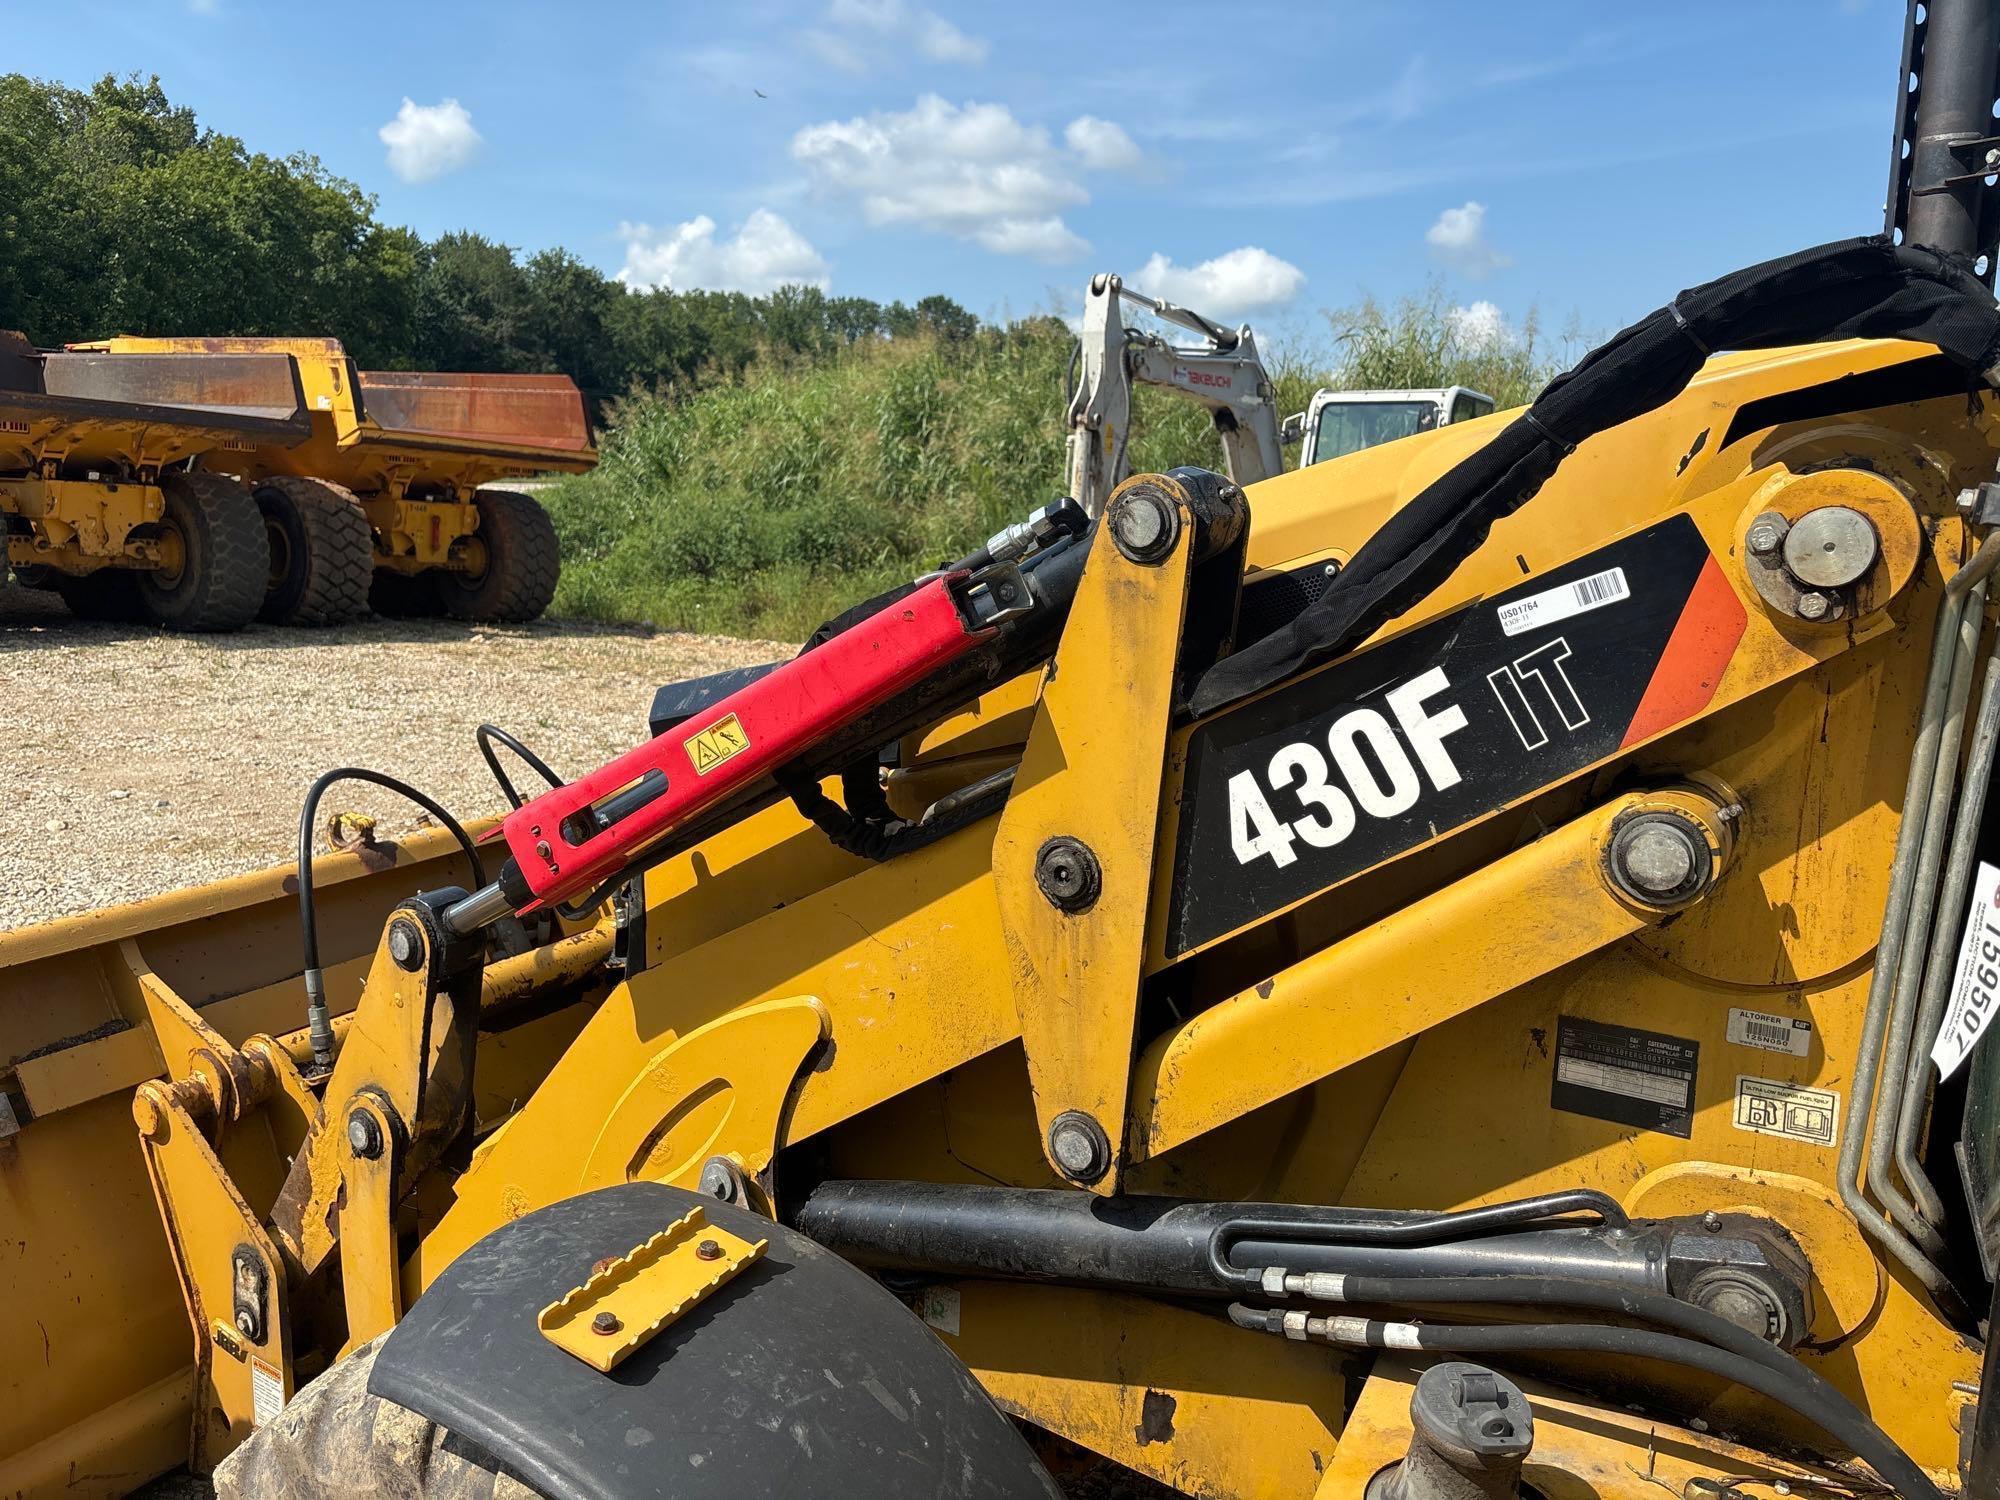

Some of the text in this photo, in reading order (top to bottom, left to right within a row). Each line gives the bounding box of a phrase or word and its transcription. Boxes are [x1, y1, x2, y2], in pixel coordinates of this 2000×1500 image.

[1500, 600, 1539, 620] US01764
[1228, 636, 1591, 869] 430F IT
[1979, 903, 1987, 931] REBEL
[1969, 939, 1980, 978] AUCTION
[1740, 1011, 1781, 1025] ALTORFER
[1955, 980, 1971, 1025] COMPANY
